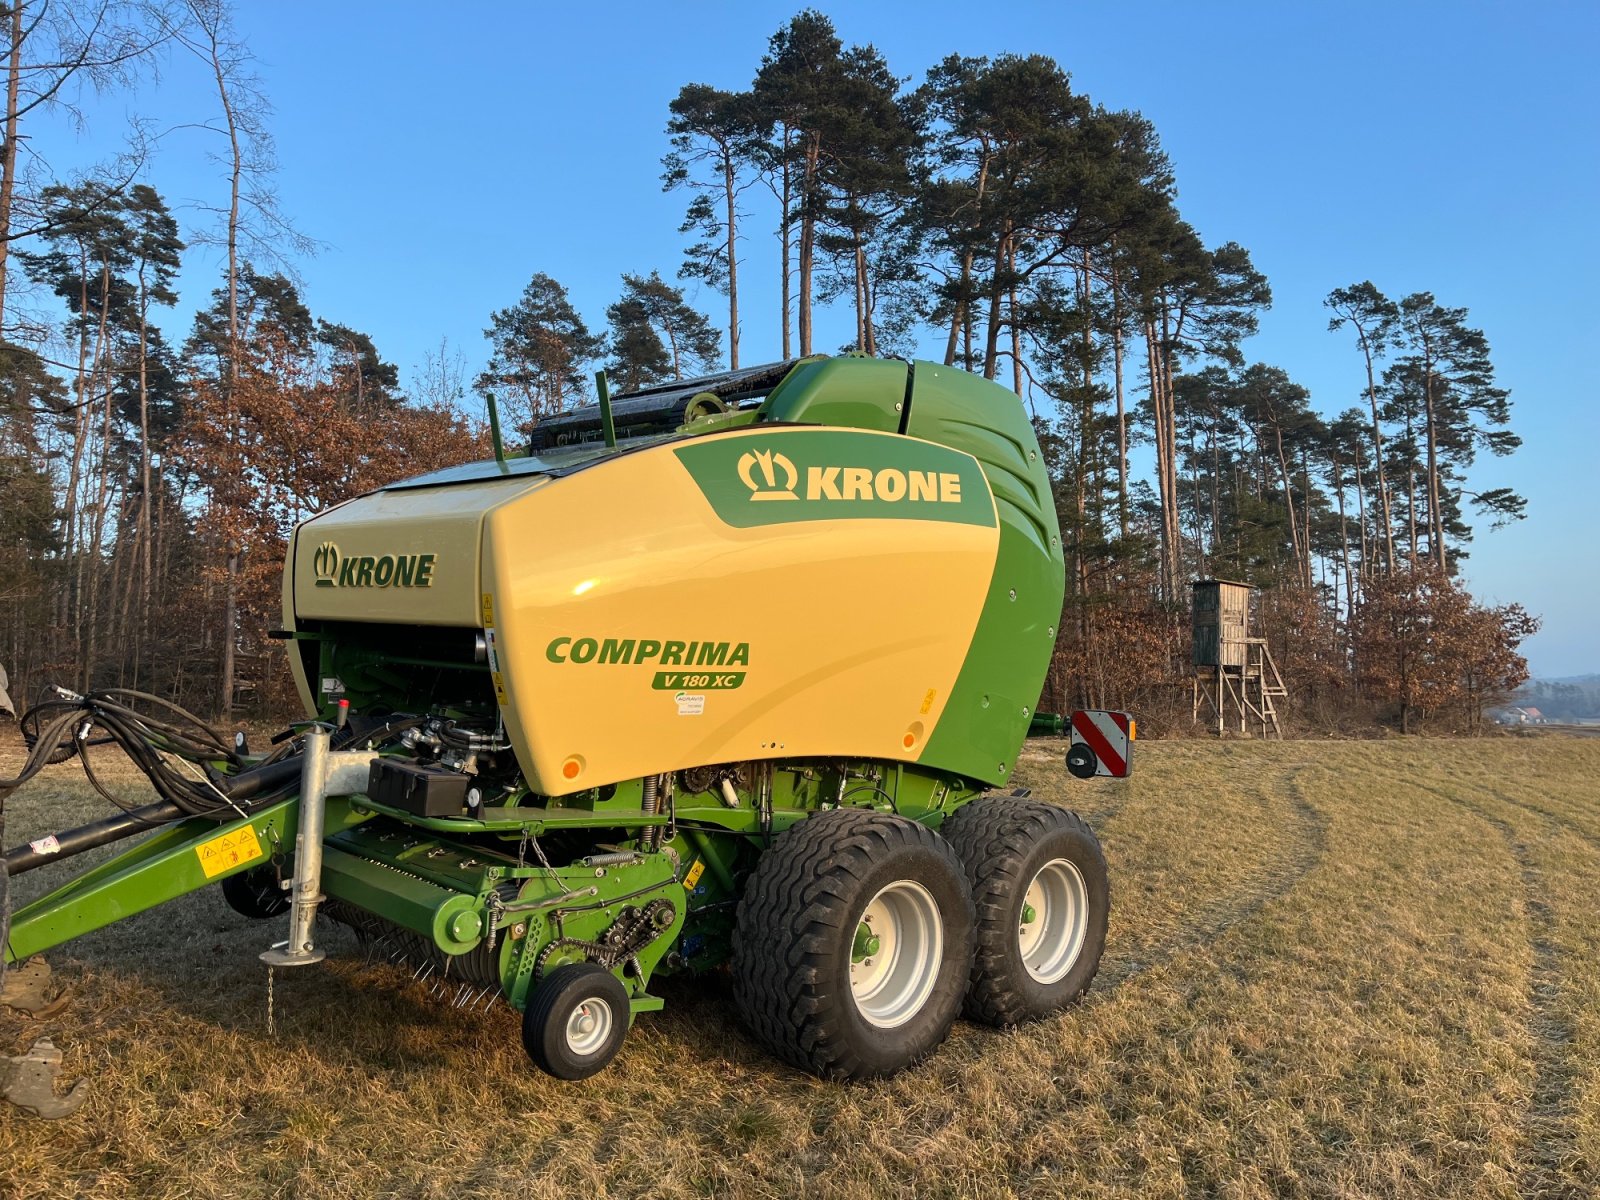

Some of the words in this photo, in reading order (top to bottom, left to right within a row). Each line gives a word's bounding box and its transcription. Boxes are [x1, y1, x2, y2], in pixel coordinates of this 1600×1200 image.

[806, 466, 962, 503] KRONE
[338, 553, 437, 588] KRONE
[545, 636, 750, 666] COMPRIMA
[664, 675, 677, 687] V
[681, 675, 709, 687] 180
[711, 675, 736, 687] XC
